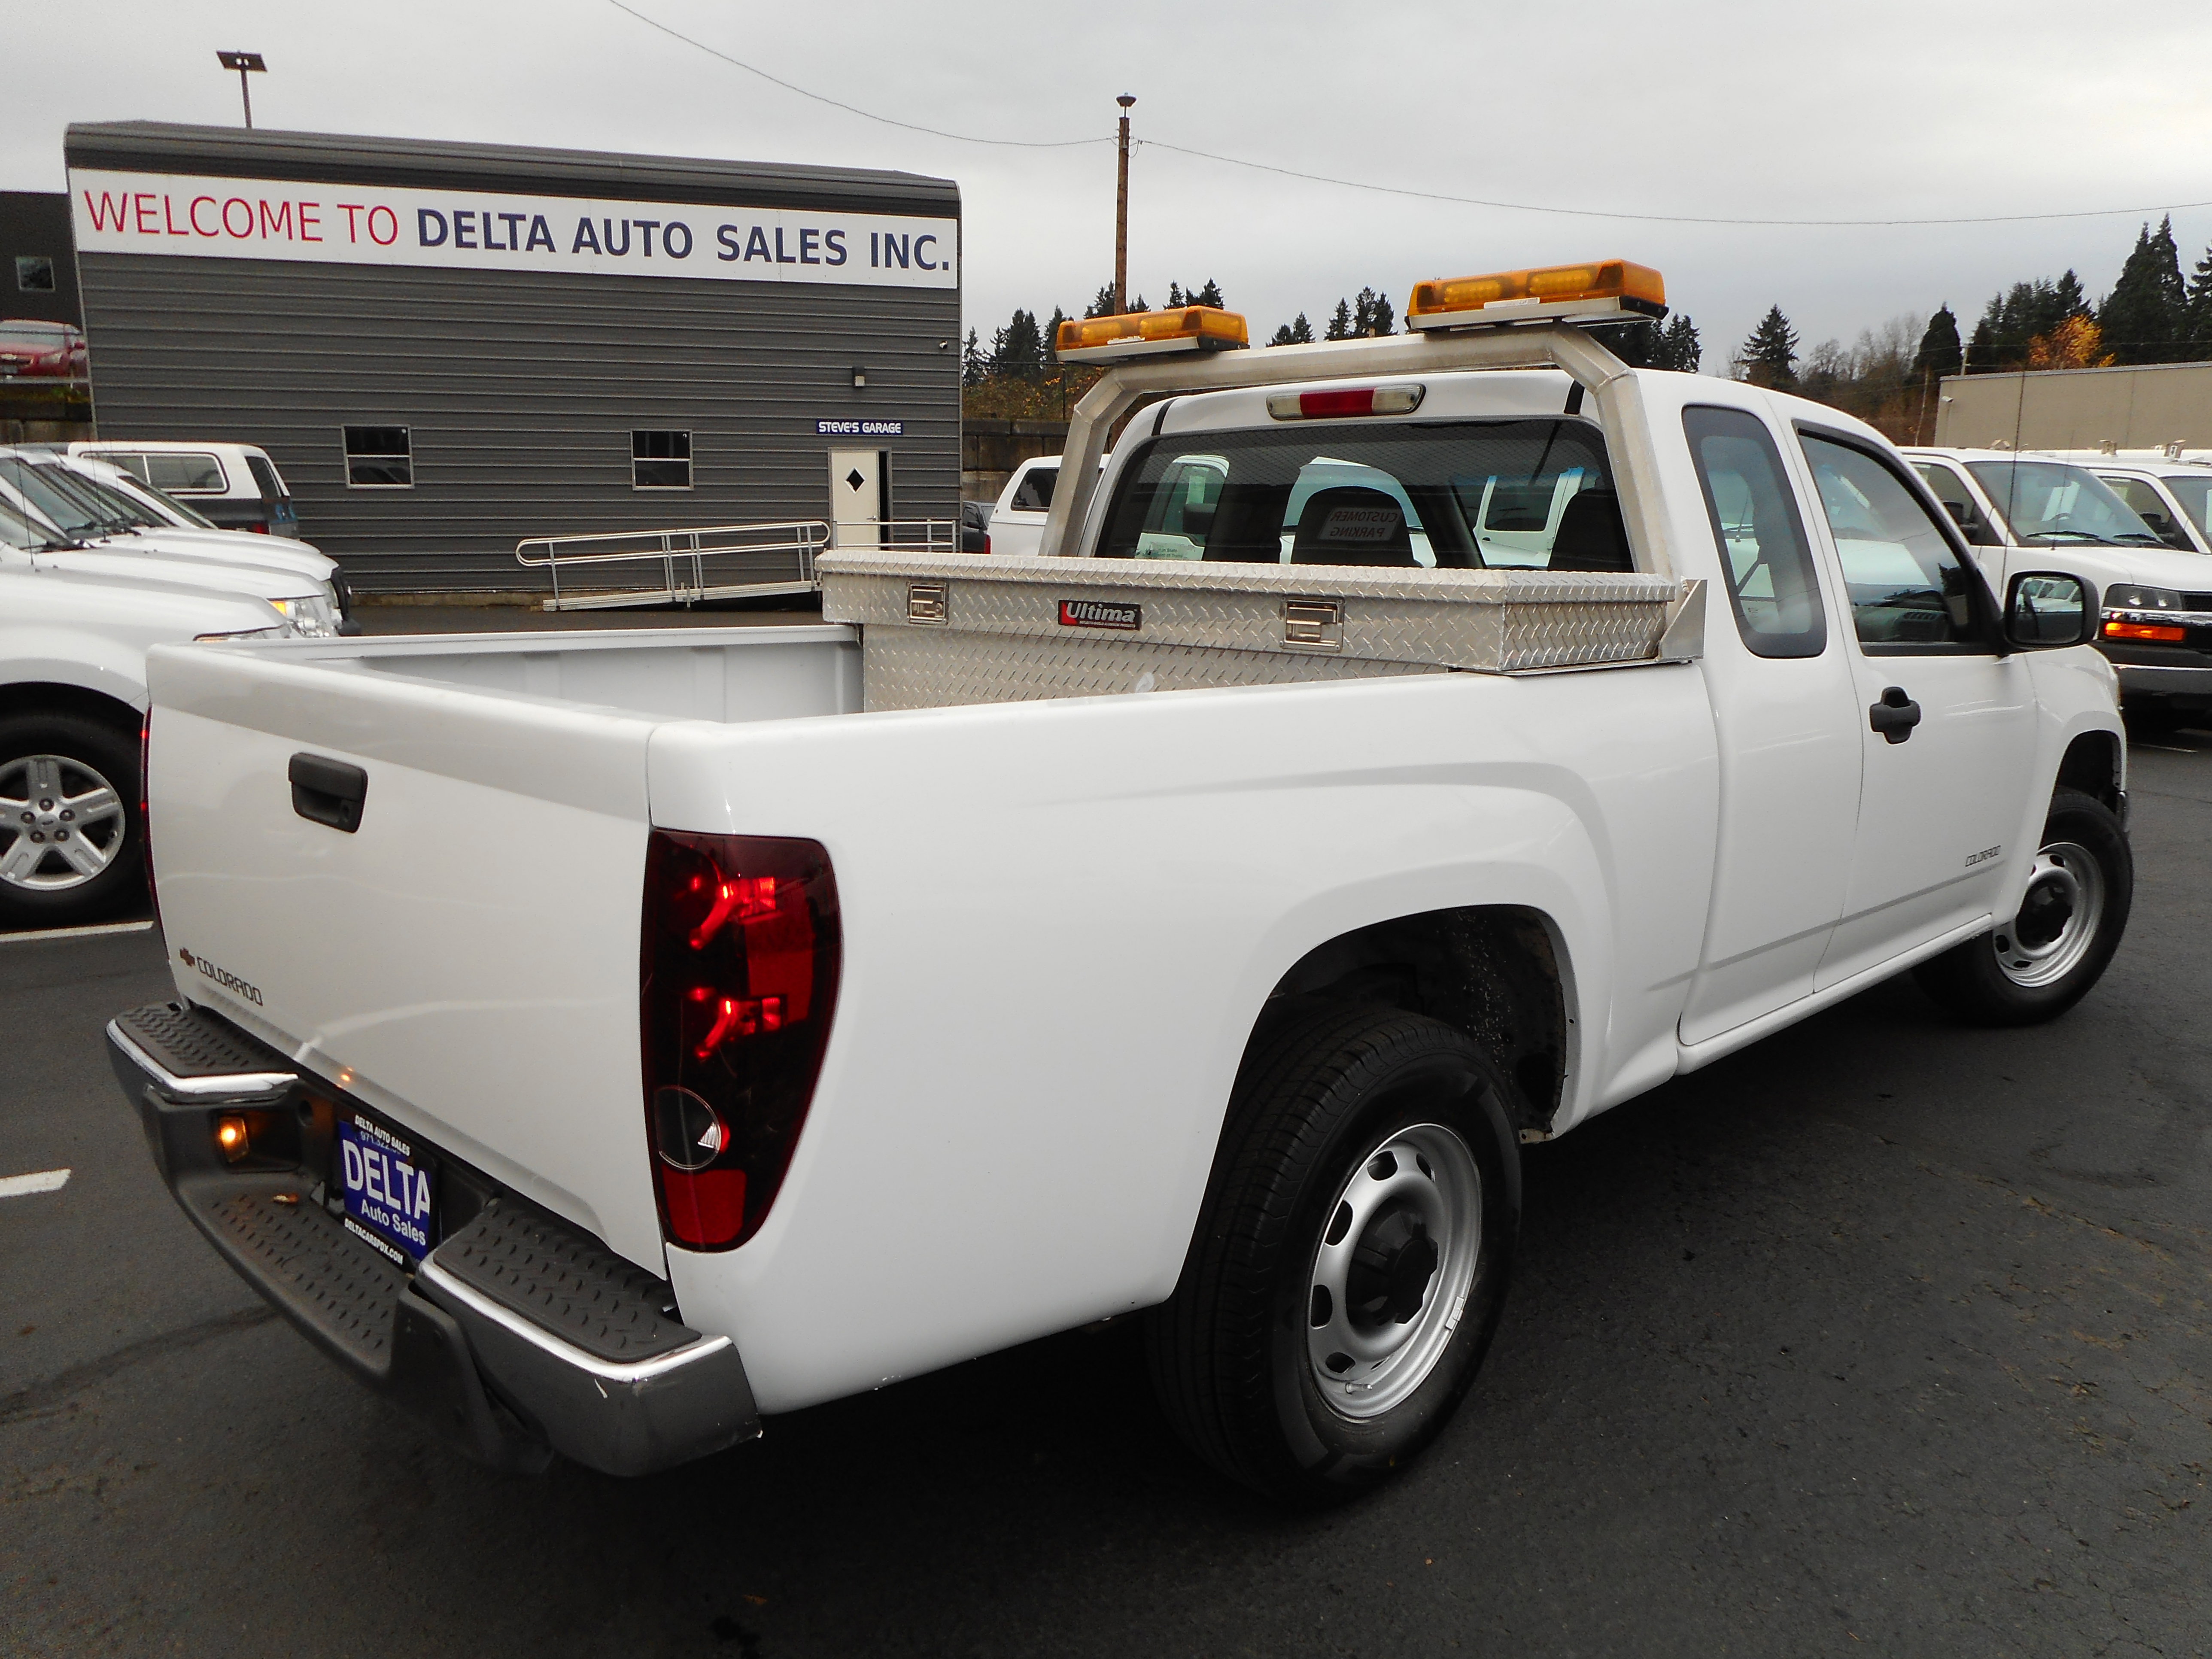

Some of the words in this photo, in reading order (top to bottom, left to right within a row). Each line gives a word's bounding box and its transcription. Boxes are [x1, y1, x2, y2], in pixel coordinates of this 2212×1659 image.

[84, 189, 323, 242] WELCOME
[337, 204, 399, 246] TO
[416, 208, 556, 253] DELTA
[572, 216, 694, 259] AUTO
[717, 223, 848, 266] SALES
[870, 232, 950, 271] INC.
[818, 421, 859, 433] STEVE'S
[862, 422, 901, 434] GARAGE
[1066, 602, 1136, 623] Ultima
[1965, 845, 2001, 867] COLORADO
[197, 957, 263, 1006] COLORADO
[355, 1115, 374, 1134] DELTA
[374, 1126, 390, 1143] AUTO
[391, 1136, 410, 1156] SALES
[343, 1139, 430, 1220] DELTA
[361, 1199, 390, 1227] Auto
[392, 1213, 426, 1246] Sales
